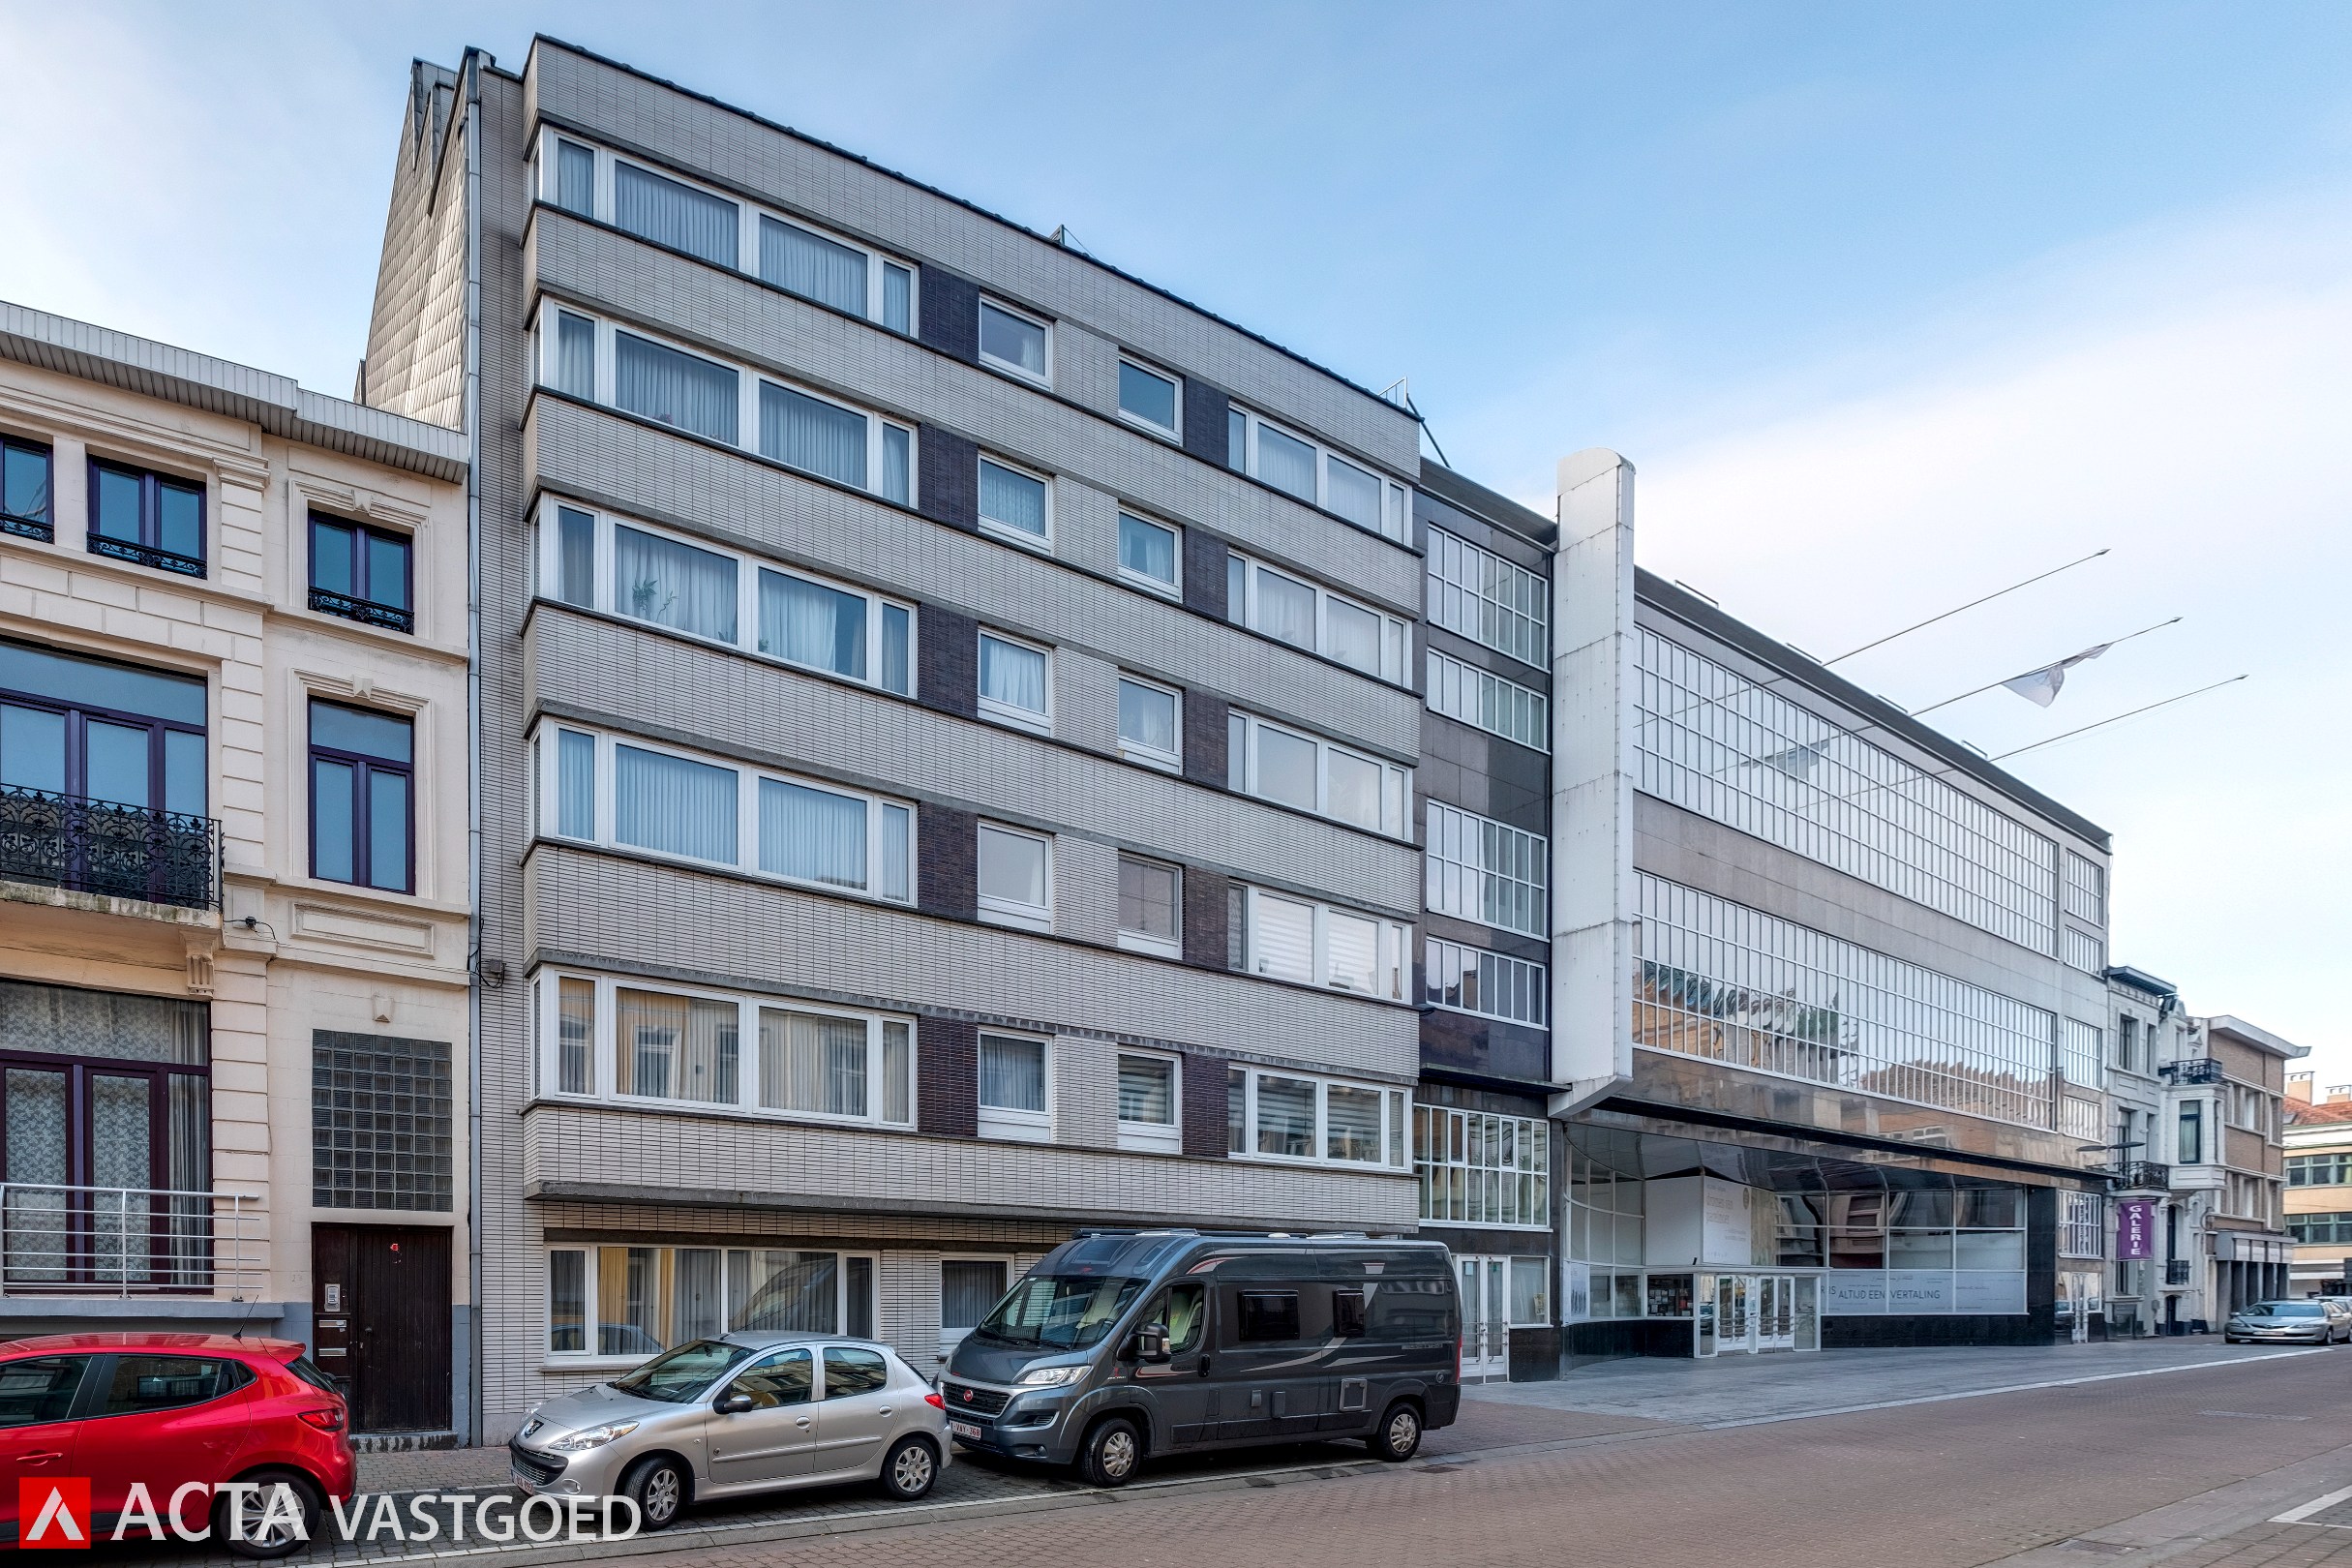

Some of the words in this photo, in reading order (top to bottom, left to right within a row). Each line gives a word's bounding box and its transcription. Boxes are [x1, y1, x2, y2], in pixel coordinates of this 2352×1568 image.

[2129, 1205, 2142, 1255] GALERIE
[1838, 1289, 1867, 1300] ALTIJD
[1868, 1289, 1886, 1300] EEN
[1889, 1289, 1941, 1299] VERTALING
